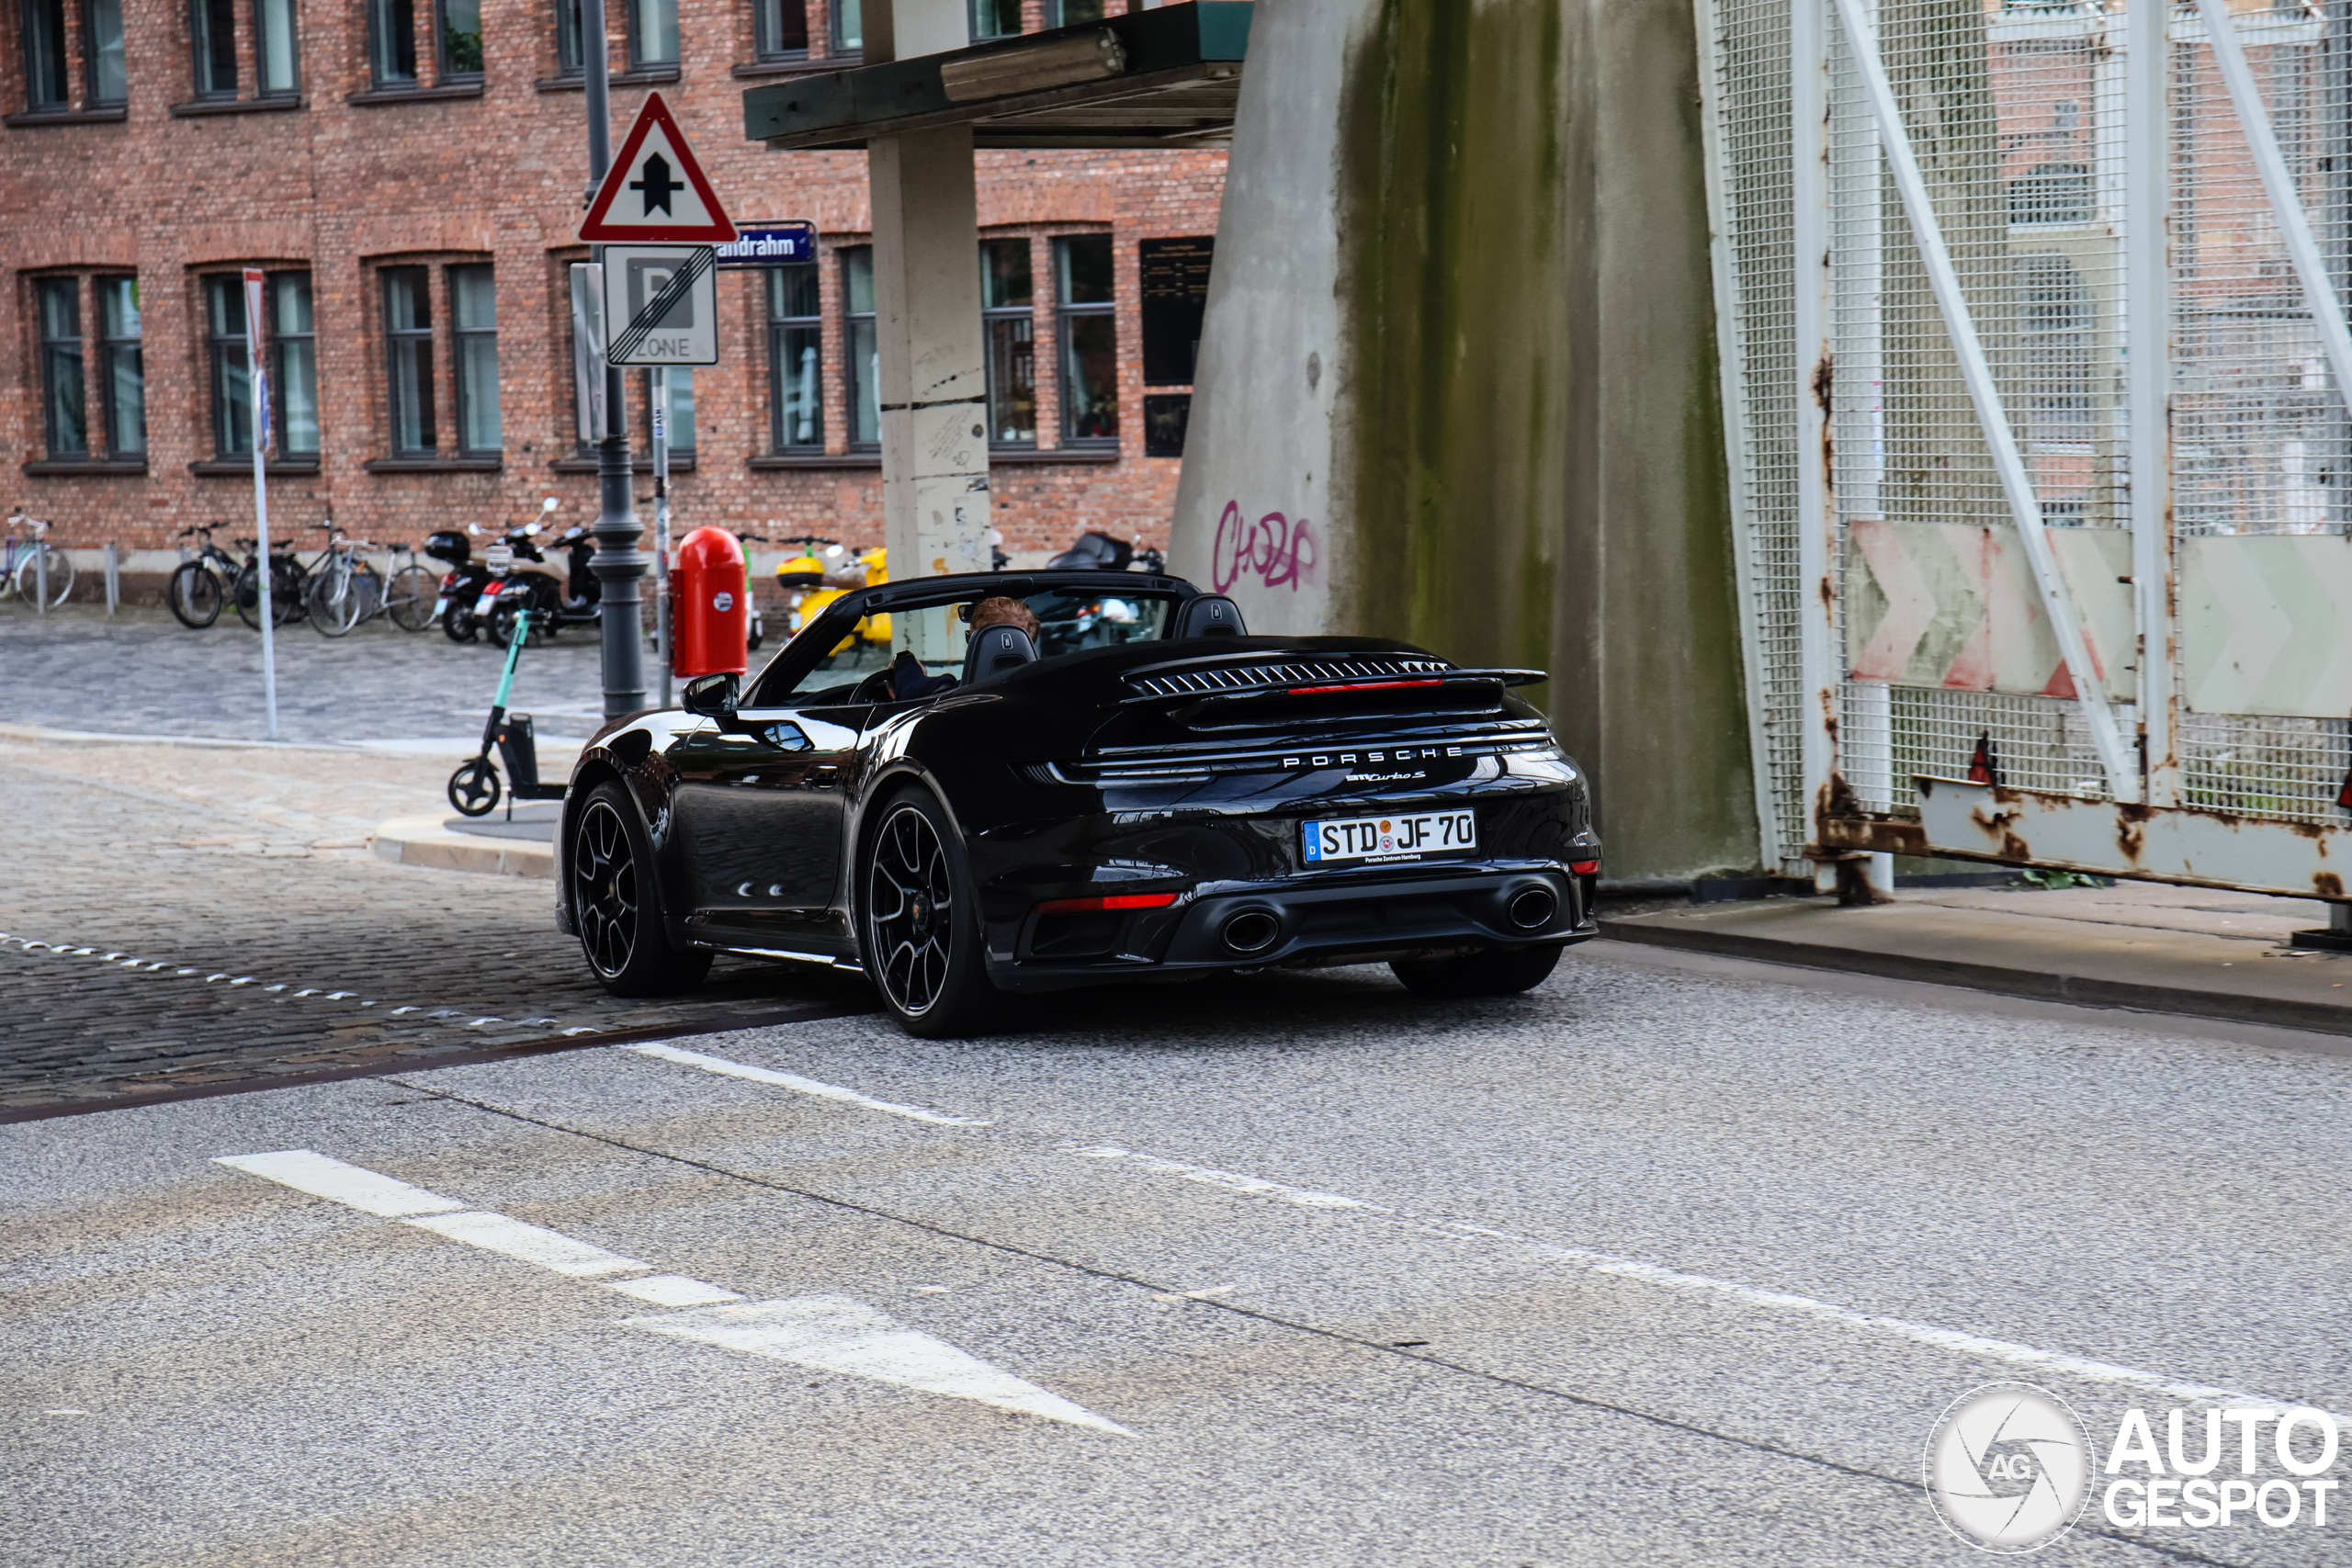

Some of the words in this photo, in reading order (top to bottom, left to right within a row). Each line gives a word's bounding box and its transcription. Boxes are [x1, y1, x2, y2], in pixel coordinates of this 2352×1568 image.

[714, 233, 795, 258] andrahm
[636, 337, 690, 356] ZONE
[1283, 746, 1464, 768] PORSCHE
[1322, 822, 1378, 855] STD
[1396, 817, 1432, 850] JF
[1438, 814, 1473, 846] 70
[1309, 845, 1317, 855] D
[1364, 855, 1383, 863] Porsche
[1383, 854, 1401, 863] Zentrum
